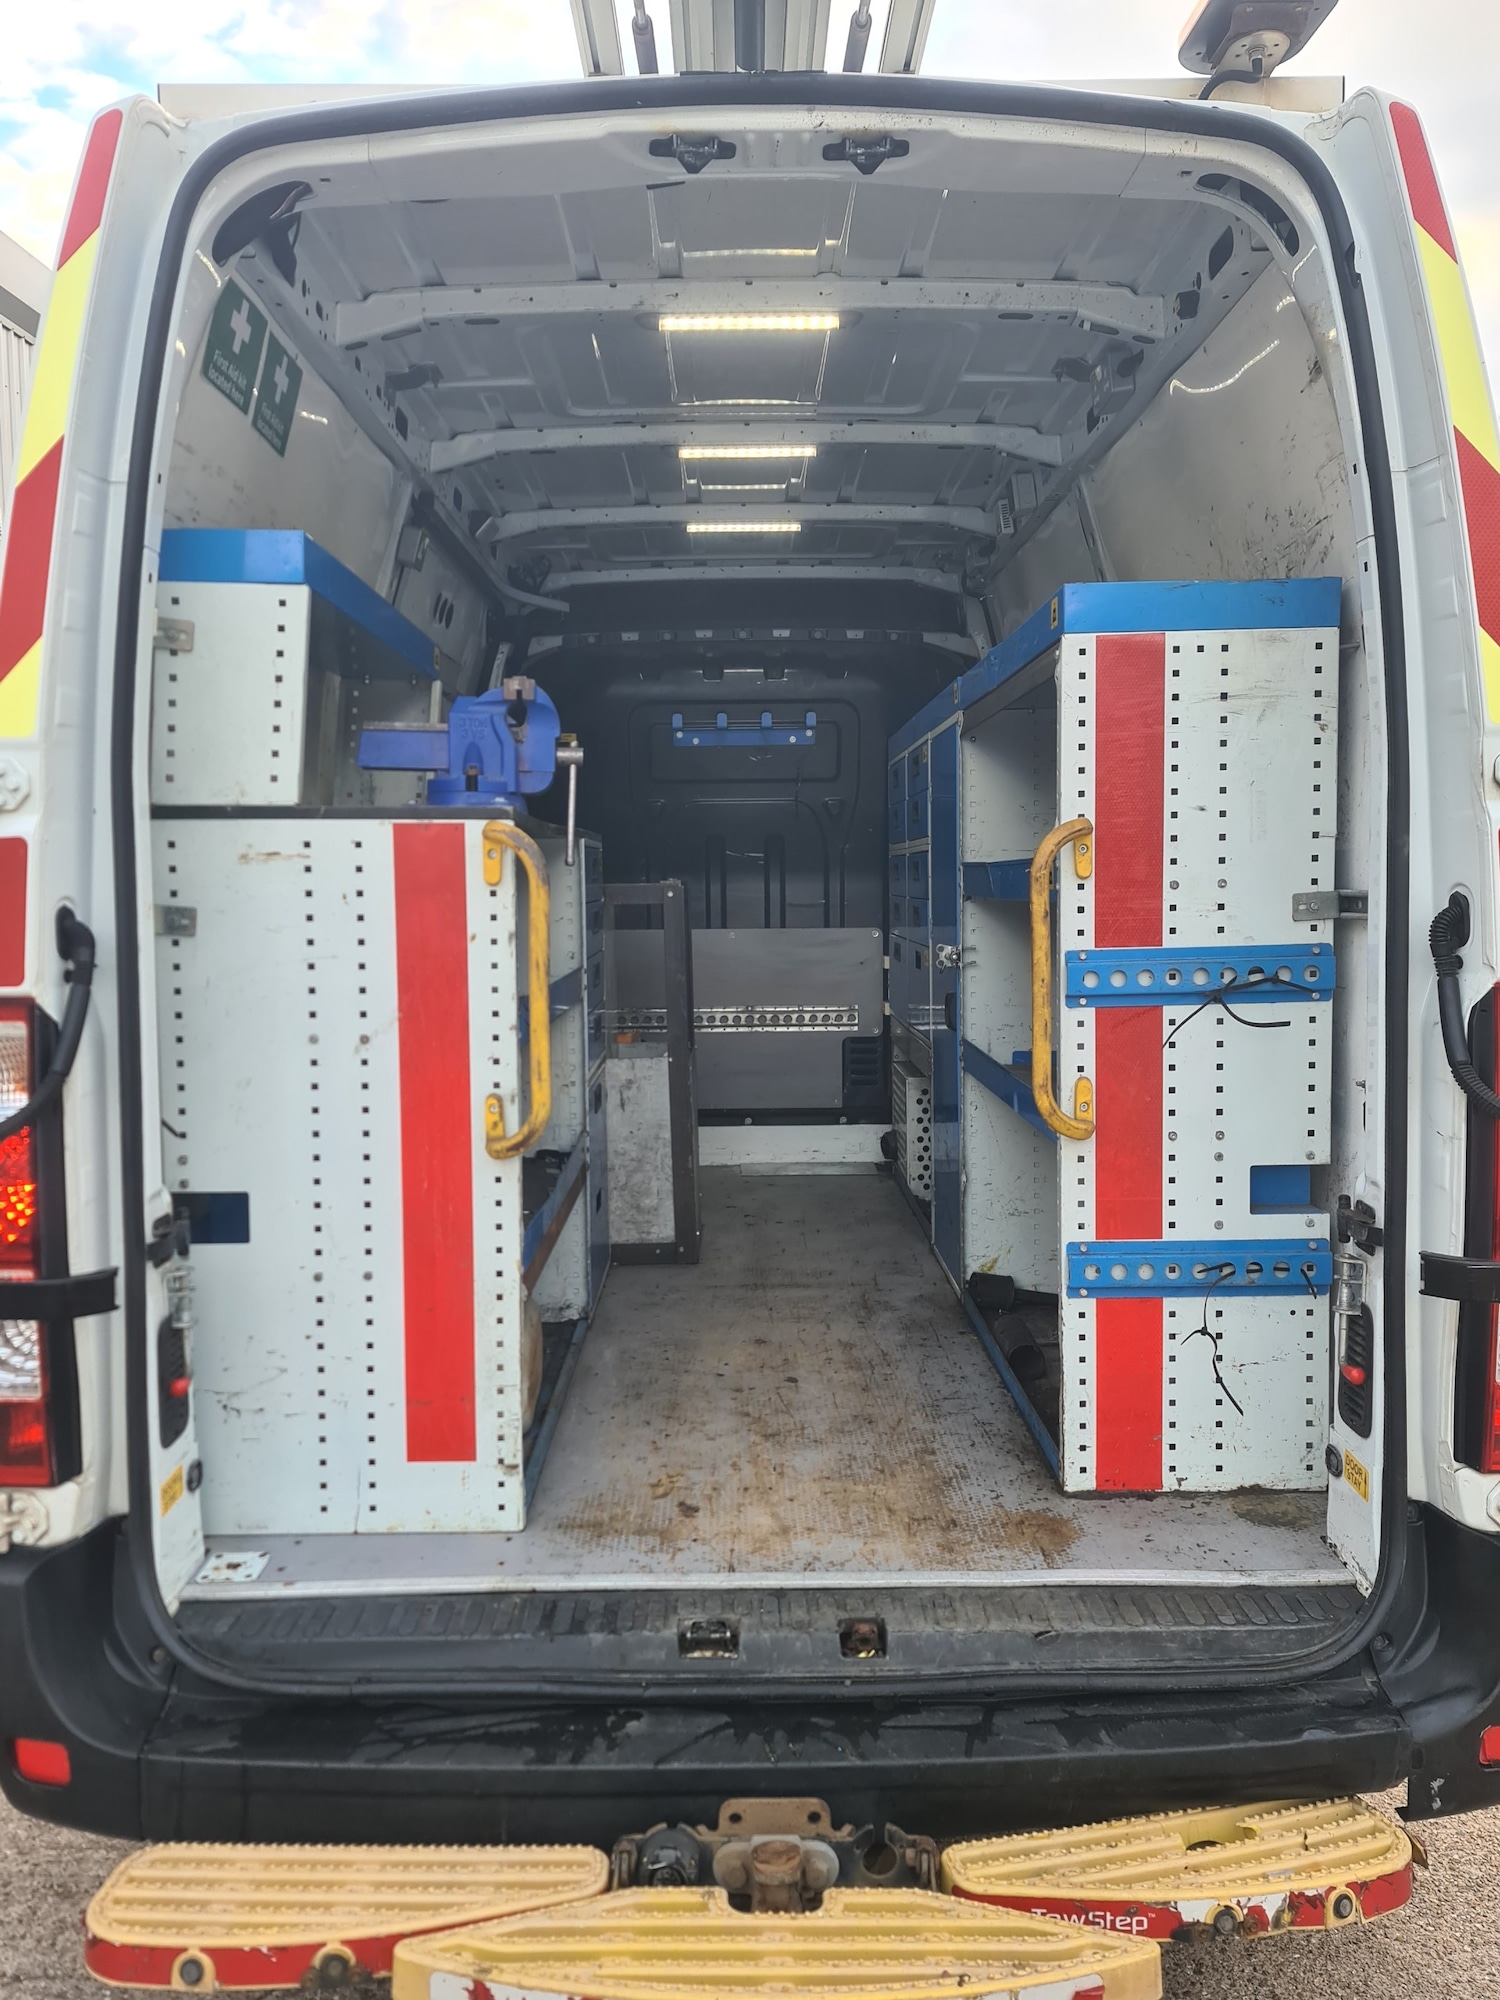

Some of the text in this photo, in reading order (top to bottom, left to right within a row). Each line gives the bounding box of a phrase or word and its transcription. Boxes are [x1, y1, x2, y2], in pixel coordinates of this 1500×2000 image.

[213, 349, 229, 373] First
[208, 362, 245, 407] located here
[1345, 1454, 1364, 1481] DOOR
[1346, 1468, 1361, 1491] STAY
